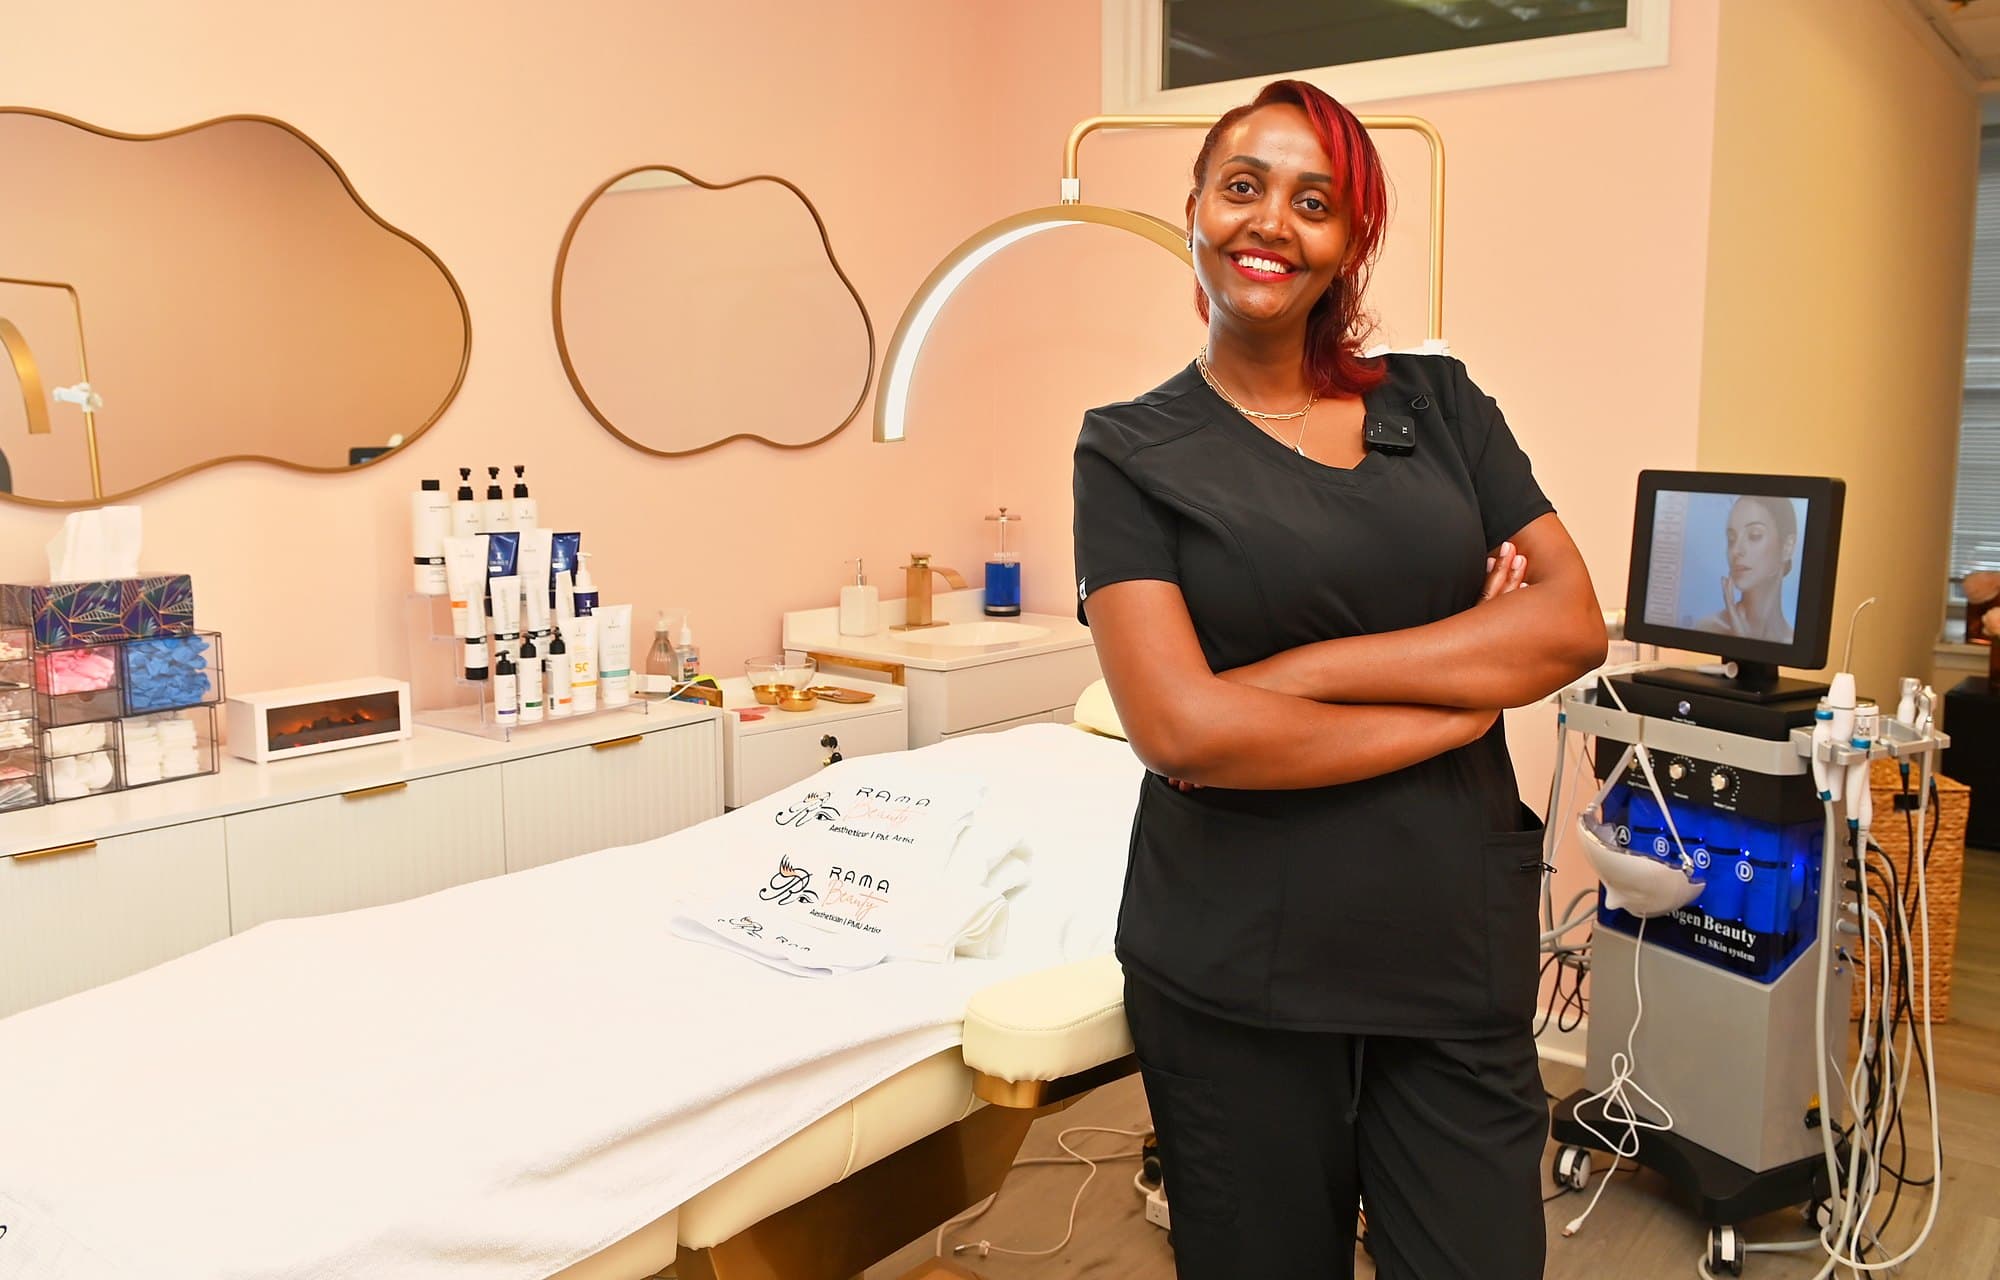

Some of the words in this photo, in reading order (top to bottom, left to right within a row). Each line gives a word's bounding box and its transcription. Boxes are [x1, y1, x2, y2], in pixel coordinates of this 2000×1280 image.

[855, 786, 931, 807] RAMA
[1617, 827, 1629, 843] A
[1655, 839, 1667, 854] B
[1695, 850, 1708, 866] C
[829, 866, 890, 893] RAMA
[1738, 864, 1751, 879] D
[821, 880, 888, 921] Beauty
[809, 909, 844, 923] Aesthetician
[847, 919, 862, 930] PMU
[1667, 908, 1701, 927] ogen
[1703, 914, 1756, 948] Beauty
[1694, 933, 1707, 945] LD
[1708, 939, 1728, 953] SKin
[1728, 947, 1756, 963] system
